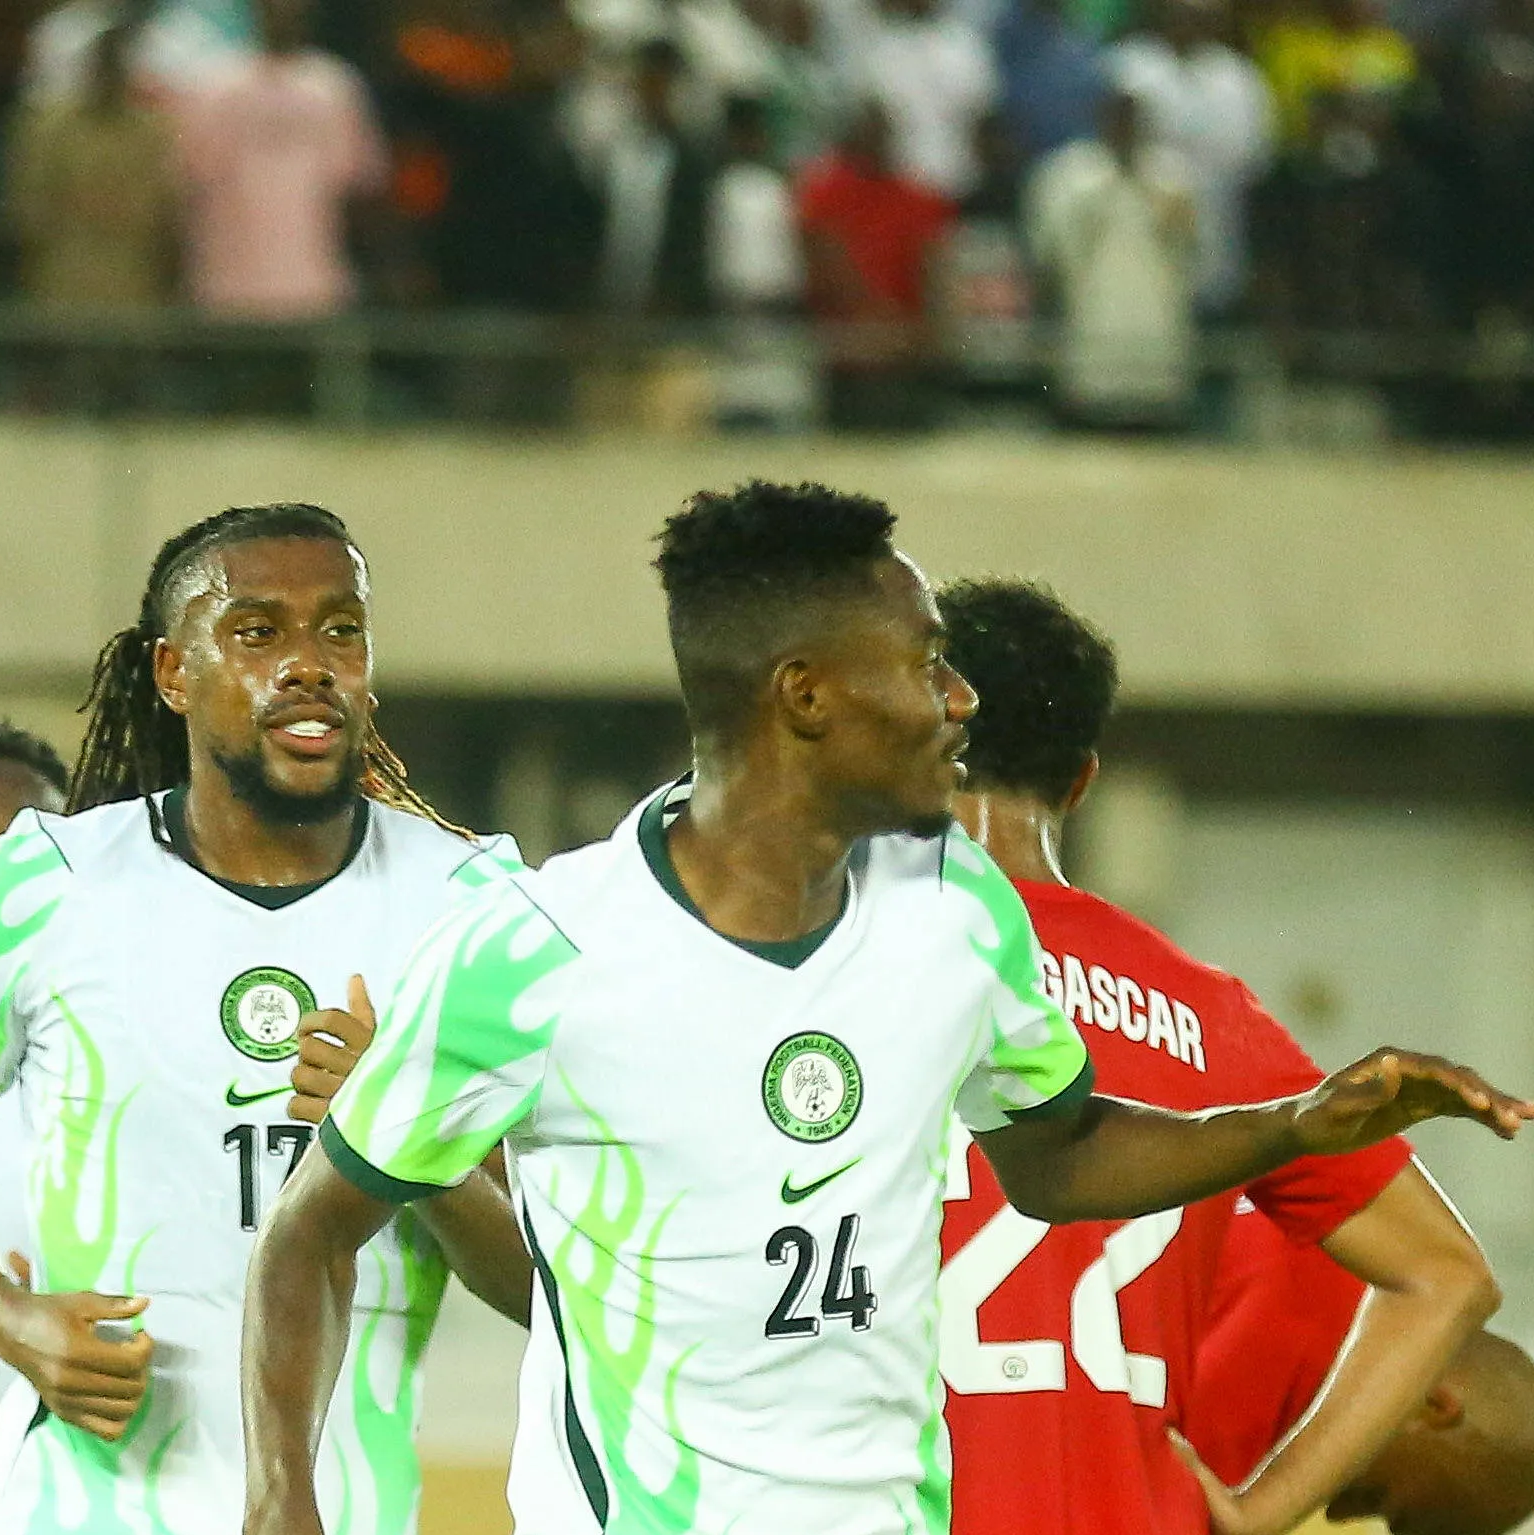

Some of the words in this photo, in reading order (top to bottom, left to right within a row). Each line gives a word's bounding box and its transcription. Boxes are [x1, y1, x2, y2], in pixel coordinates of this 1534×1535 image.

[1038, 949, 1208, 1072] GASCAR
[224, 1124, 314, 1232] 17
[765, 1213, 878, 1340] 24
